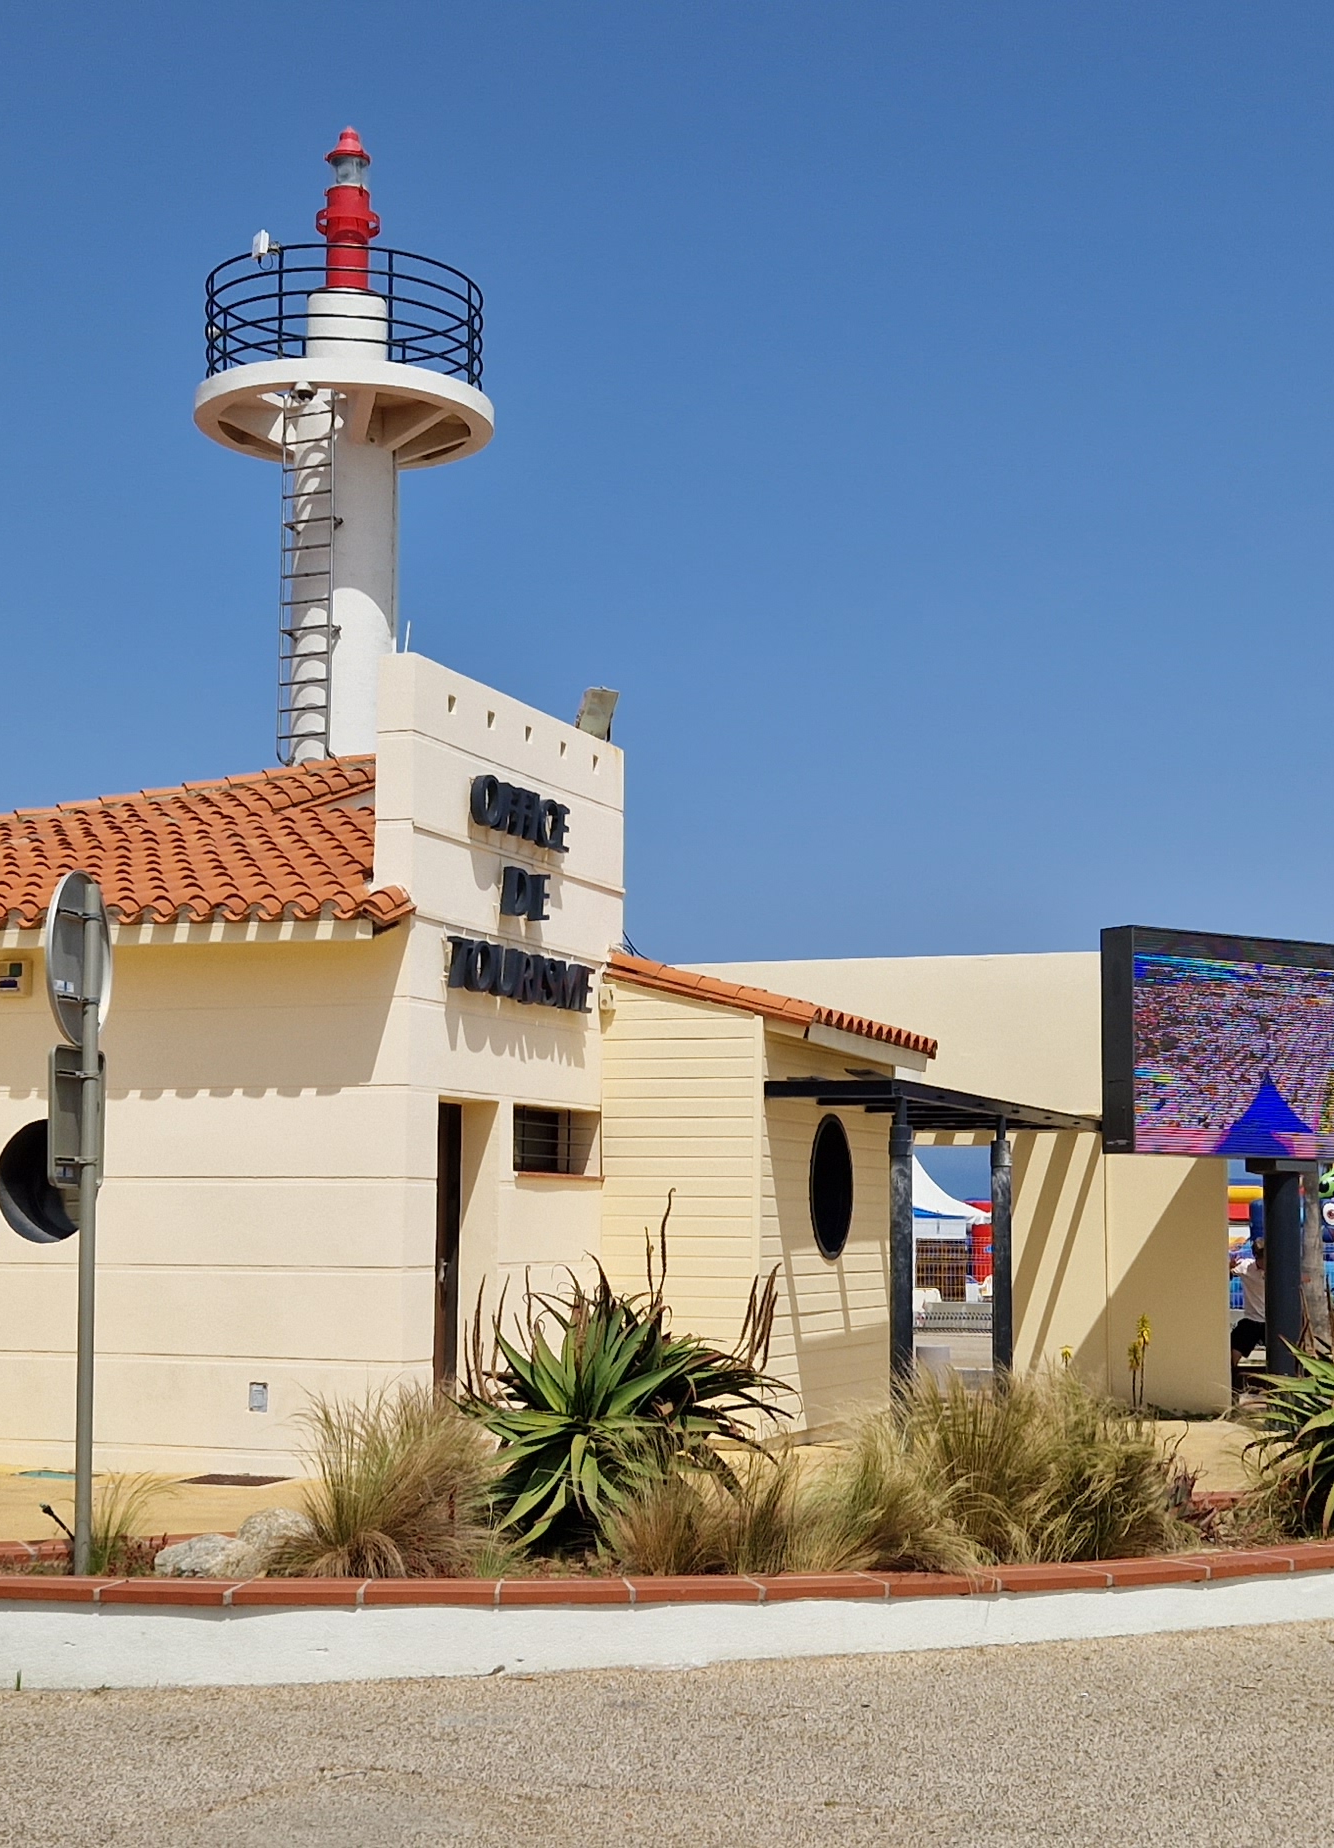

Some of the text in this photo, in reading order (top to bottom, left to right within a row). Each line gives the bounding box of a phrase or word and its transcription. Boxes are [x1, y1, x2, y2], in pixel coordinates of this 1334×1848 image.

[470, 775, 571, 853] OFFICE
[500, 866, 551, 922] DE
[447, 935, 596, 1014] TOURISME
